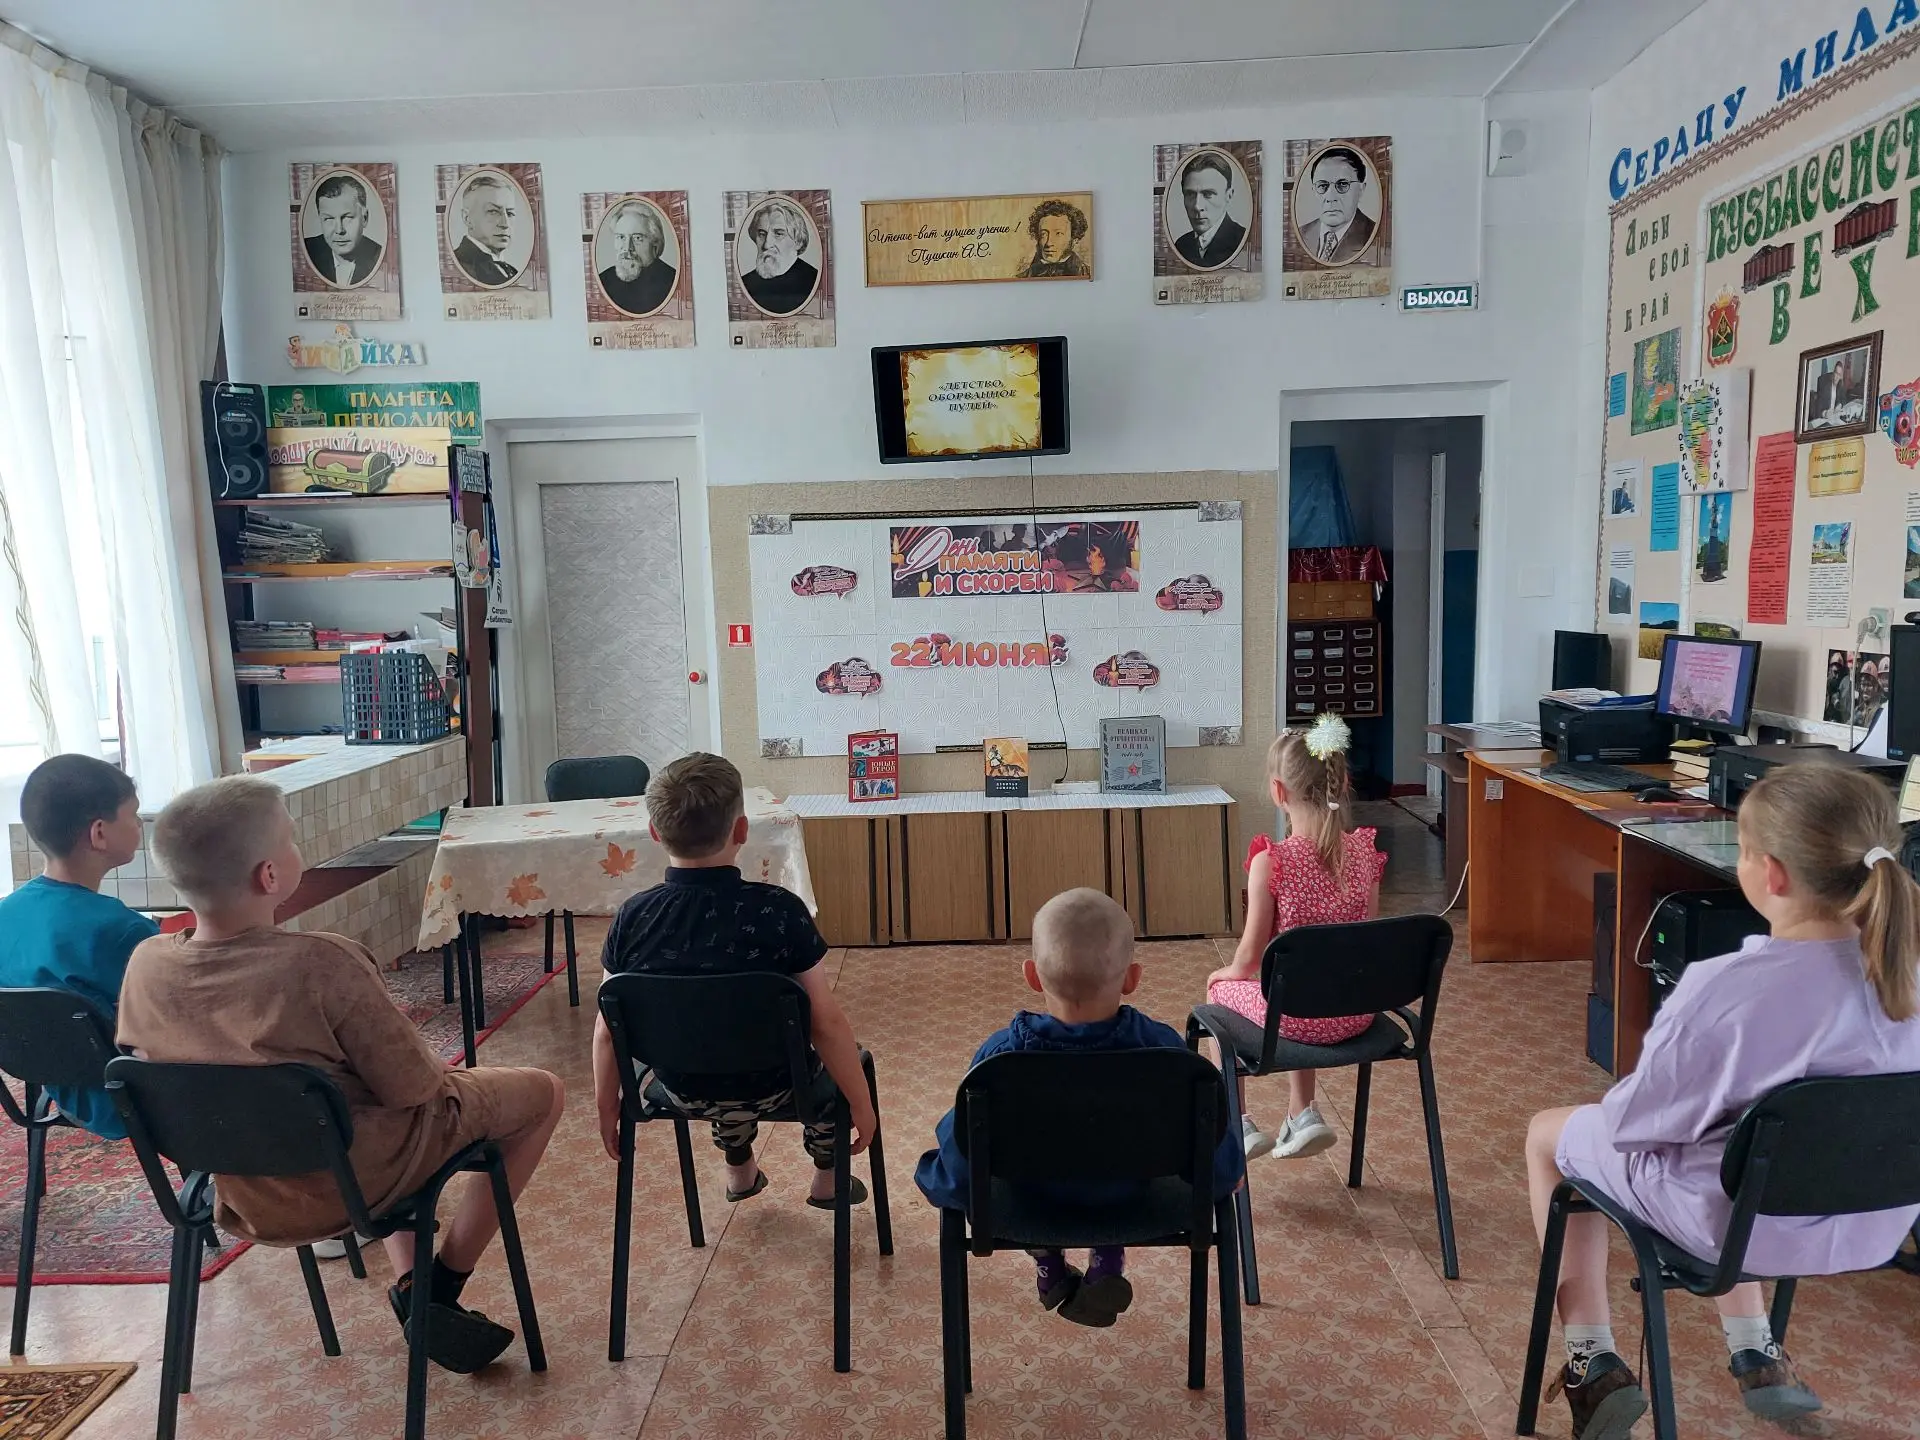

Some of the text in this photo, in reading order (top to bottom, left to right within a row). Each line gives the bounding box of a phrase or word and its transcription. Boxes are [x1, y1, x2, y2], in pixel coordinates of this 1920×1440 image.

[941, 226, 976, 242] лучшее
[979, 225, 1010, 240] учение
[908, 242, 992, 265] Пушкин А.С.
[1650, 244, 1689, 281] СВОЙ
[1407, 290, 1468, 306] ВЫХОД
[1624, 292, 1669, 332] КРАЙ
[350, 390, 454, 408] ПЛАНЕТА
[928, 390, 1017, 402] ОБОРВАННОЕ
[334, 411, 475, 428] ПЕРИОДИКИ
[894, 527, 980, 580] День
[938, 551, 1041, 574] ПАМЯТИ
[934, 571, 1054, 596] И СКОРБИ
[890, 642, 1050, 667] 22 ИЮНЯ
